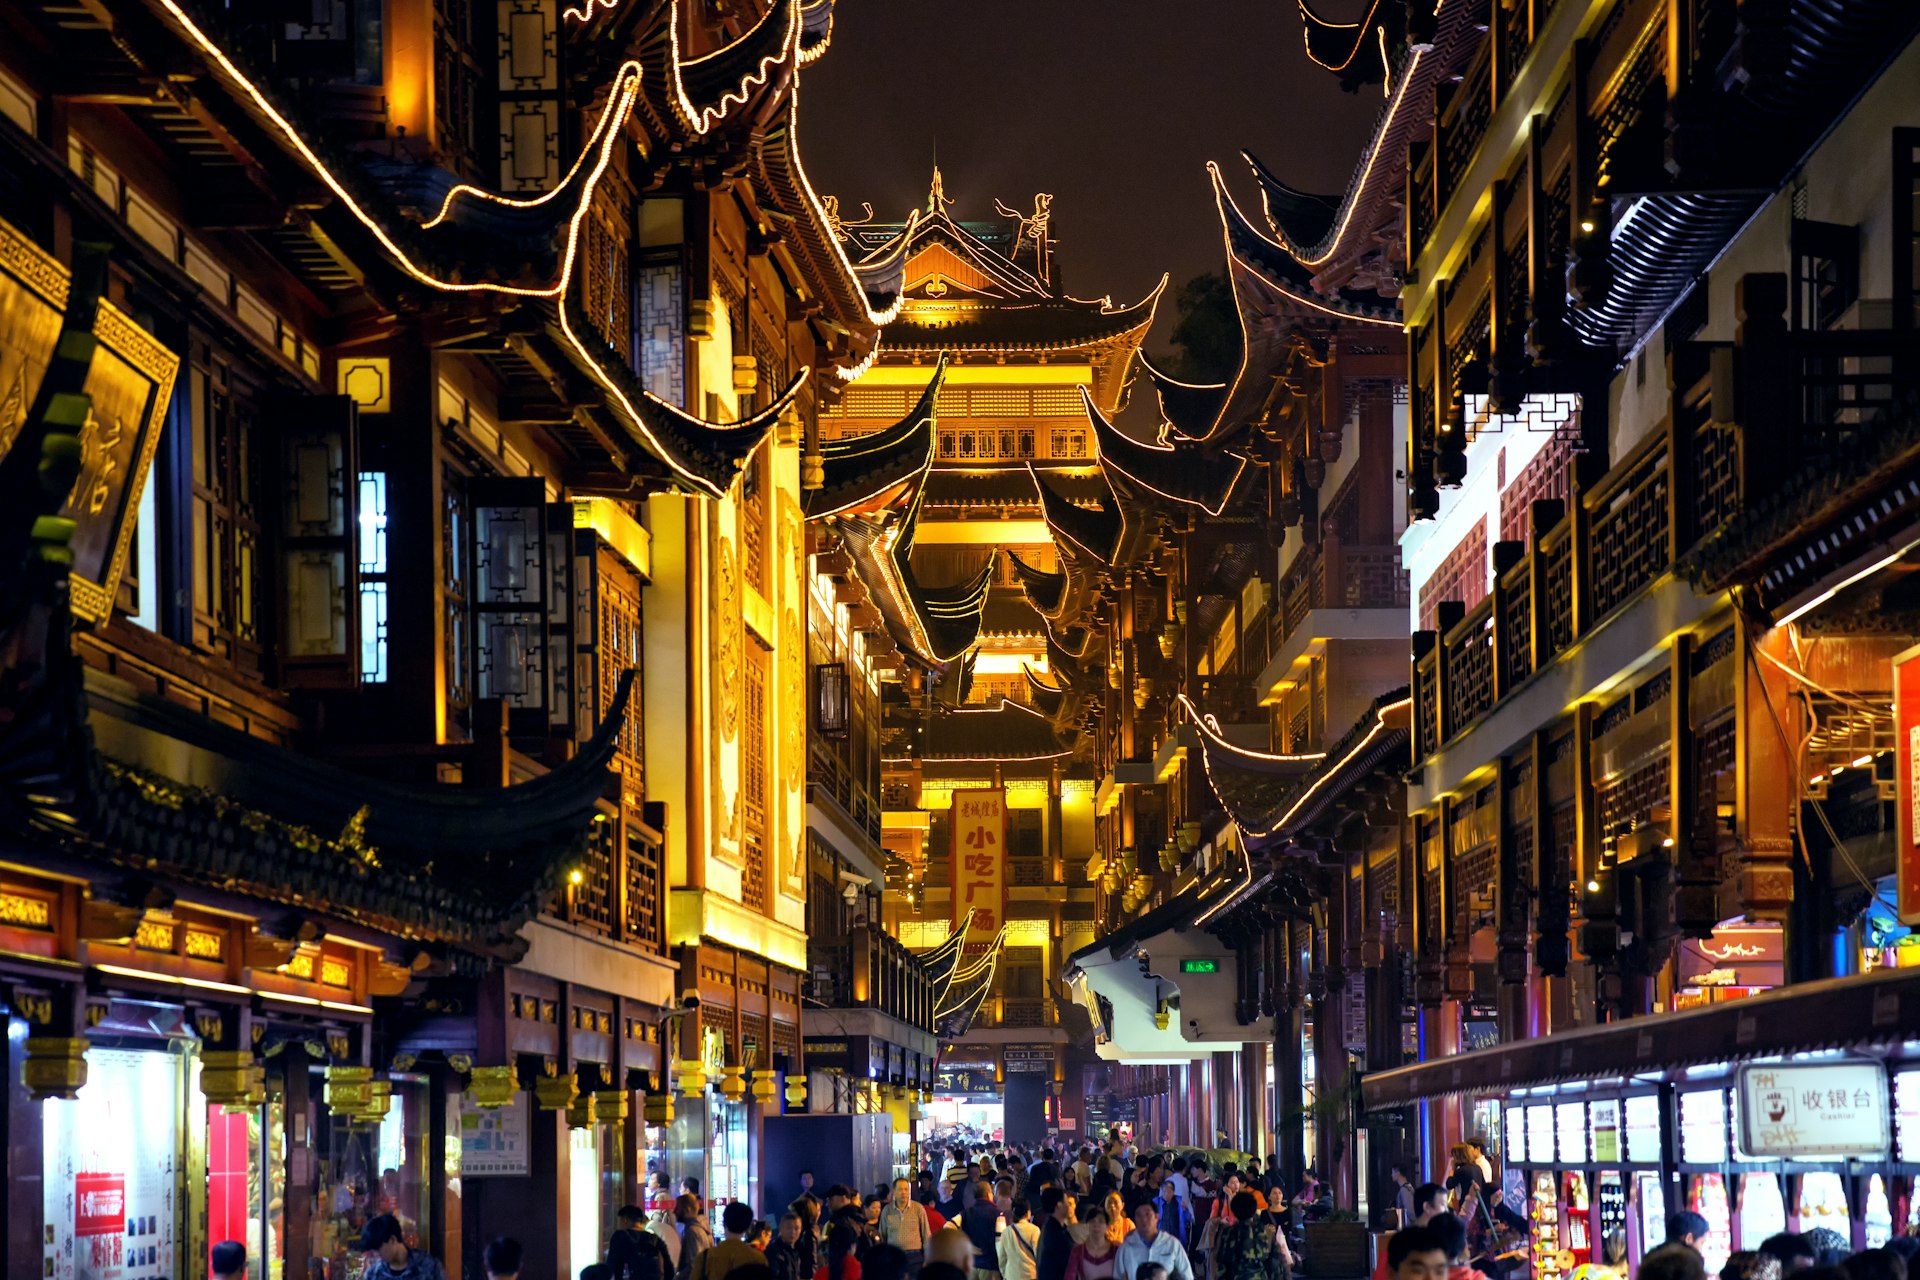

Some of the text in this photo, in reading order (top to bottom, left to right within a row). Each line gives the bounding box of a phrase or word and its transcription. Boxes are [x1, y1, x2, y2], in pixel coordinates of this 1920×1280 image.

[964, 825, 996, 932] 小吃广场
[1802, 1087, 1871, 1110] 收银台
